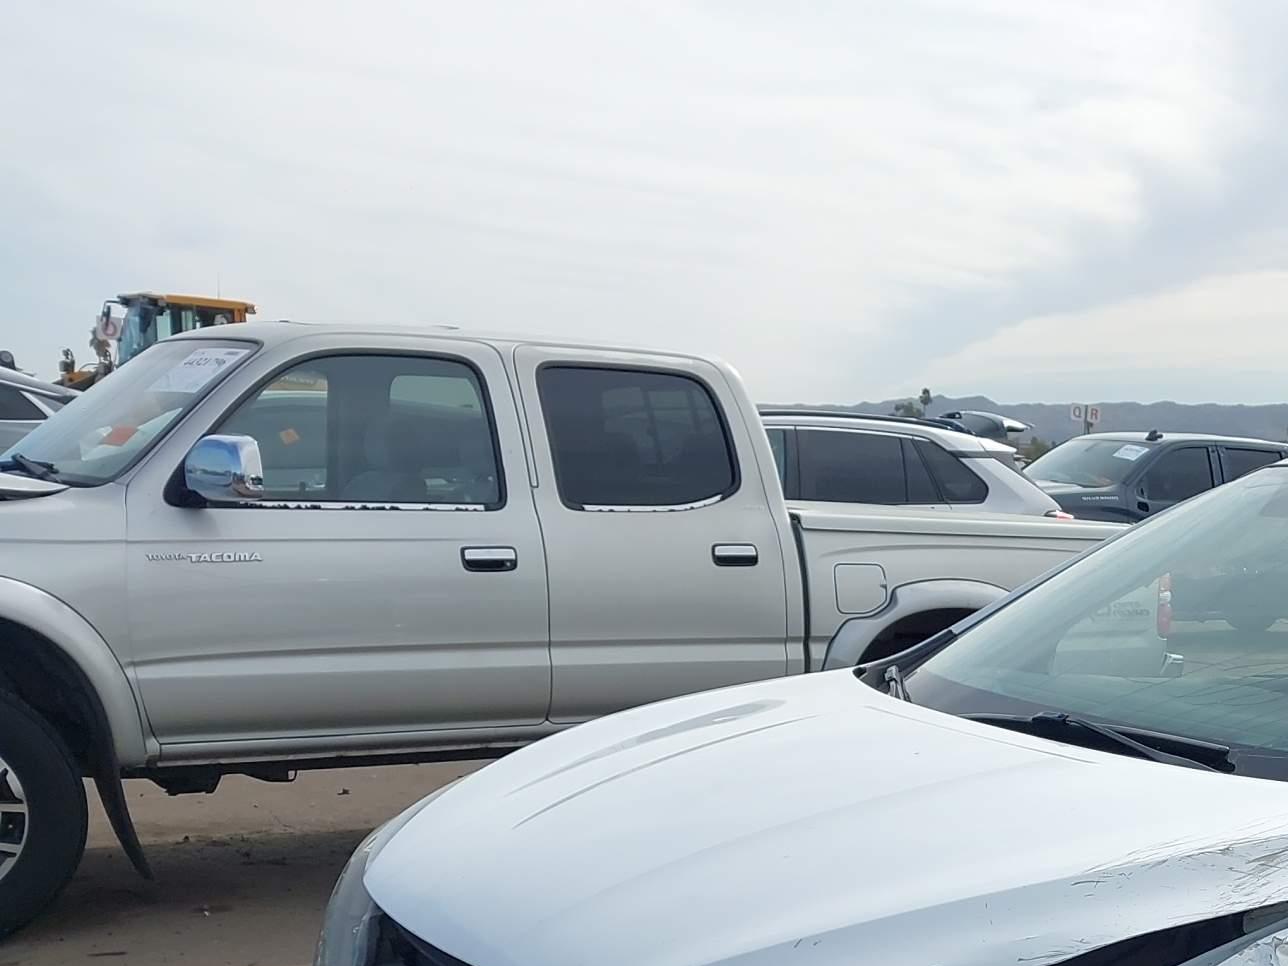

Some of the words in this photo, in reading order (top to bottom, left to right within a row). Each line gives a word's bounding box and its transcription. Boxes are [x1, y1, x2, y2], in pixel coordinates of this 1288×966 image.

[1073, 406, 1082, 418] Q
[1090, 408, 1098, 420] R
[144, 552, 187, 561] TOYOTA
[187, 552, 263, 563] TACOMA
